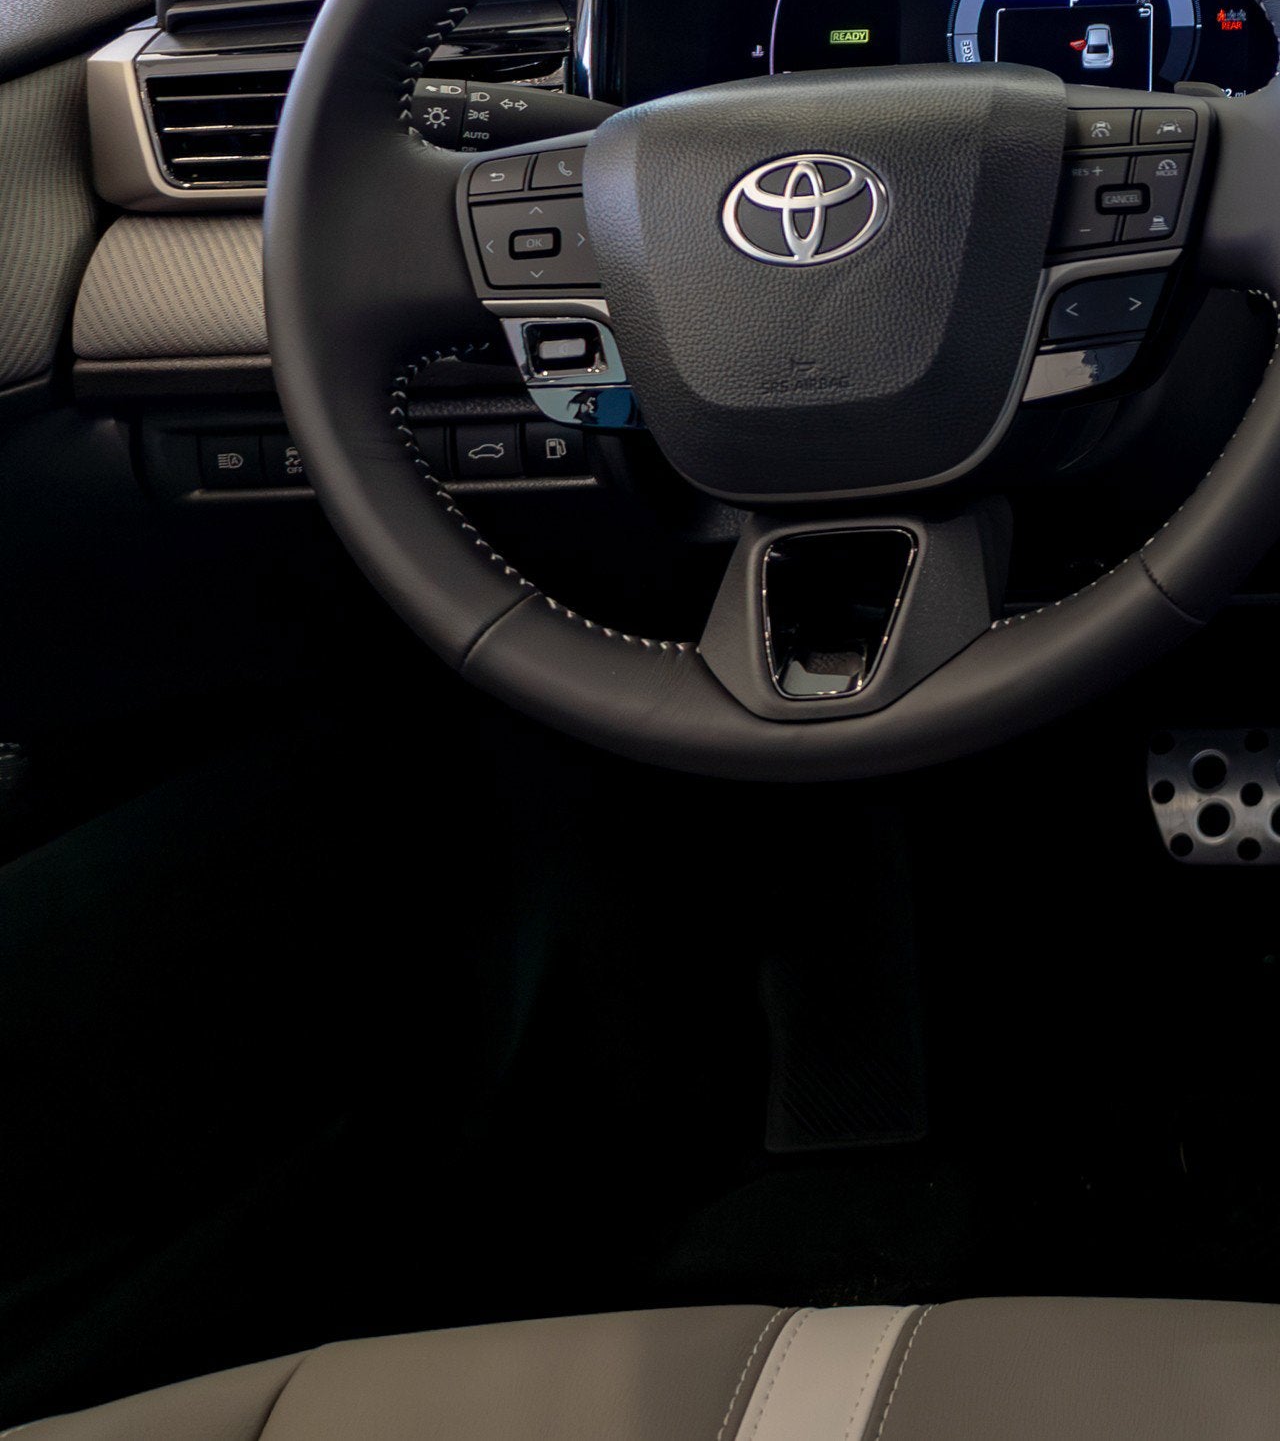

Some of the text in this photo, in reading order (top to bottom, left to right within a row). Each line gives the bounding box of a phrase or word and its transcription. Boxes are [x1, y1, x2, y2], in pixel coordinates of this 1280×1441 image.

[1221, 21, 1242, 31] REAR
[833, 31, 867, 41] READY
[1235, 89, 1246, 98] mi
[463, 131, 490, 140] AUTO
[1104, 194, 1139, 205] CANCEL
[526, 238, 543, 248] OK
